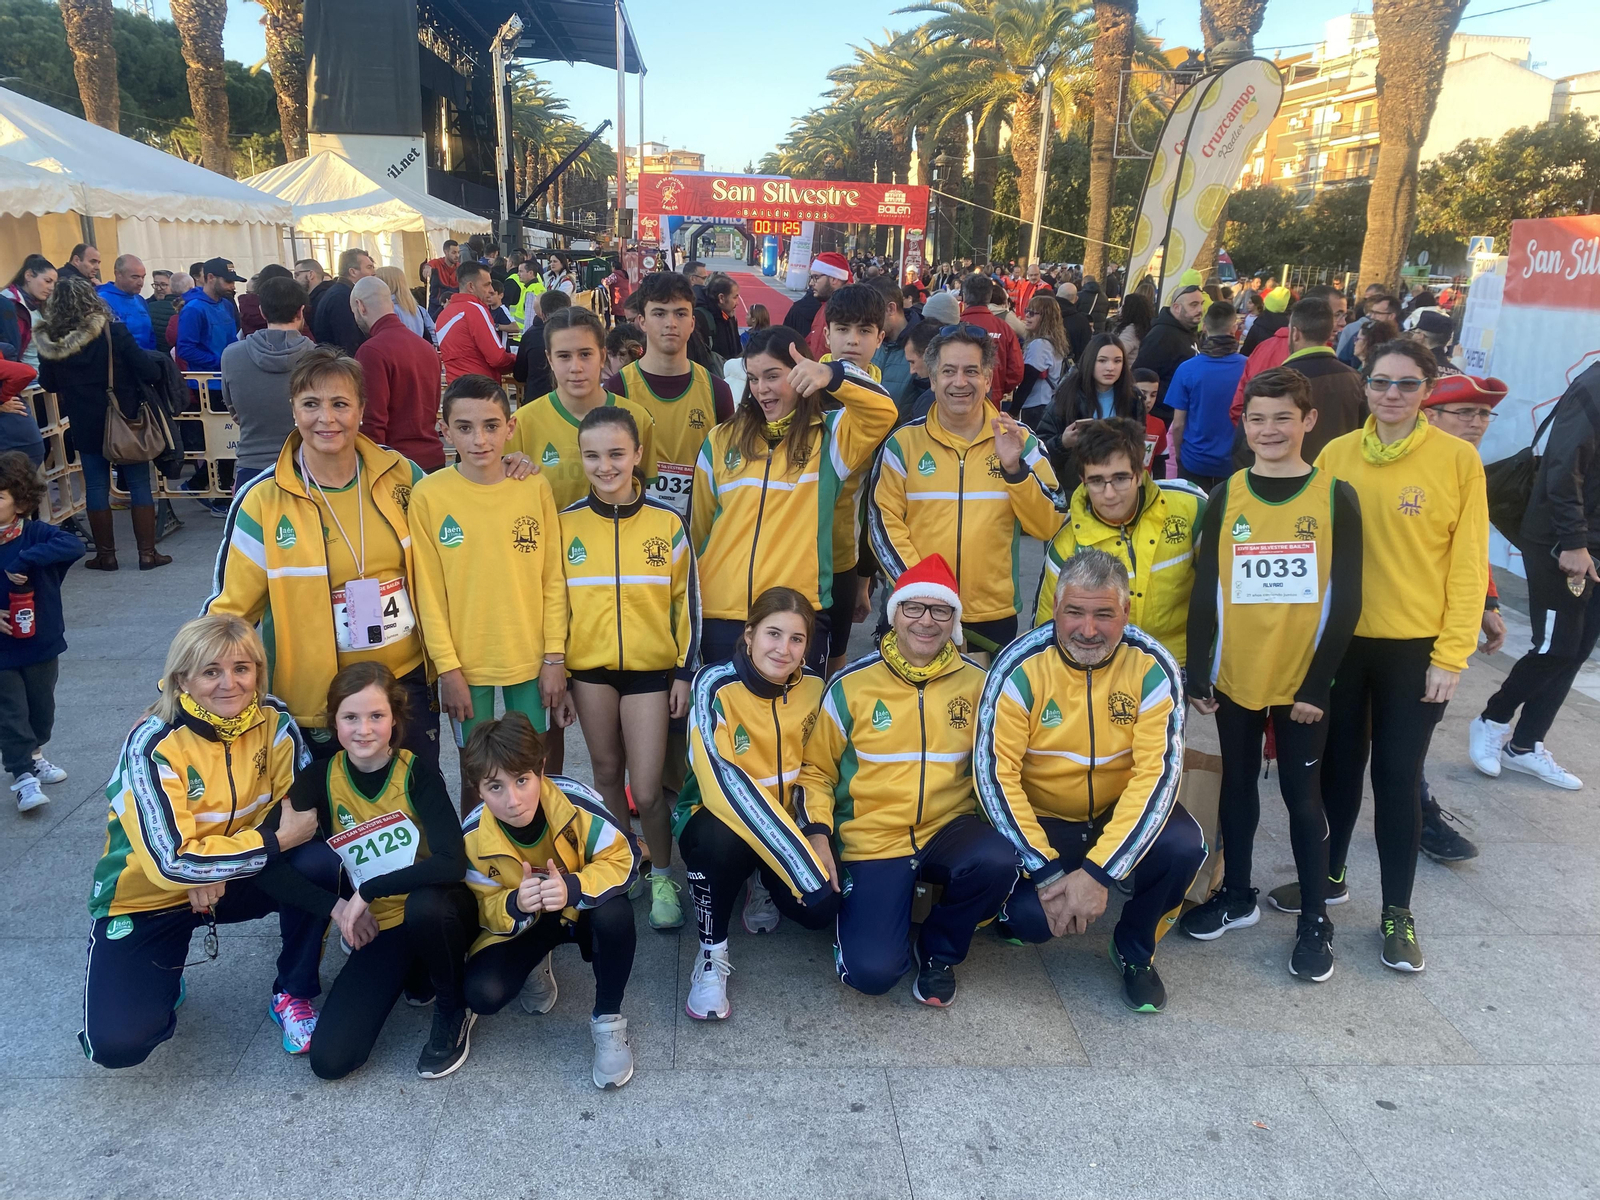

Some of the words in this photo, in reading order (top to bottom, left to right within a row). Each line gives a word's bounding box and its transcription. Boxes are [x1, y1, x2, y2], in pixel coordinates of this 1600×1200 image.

[1202, 84, 1256, 158] Cruzcampo
[1218, 124, 1245, 159] Radler
[387, 147, 420, 179] il.net
[712, 179, 756, 203] San
[762, 181, 860, 207] Silvestre
[743, 208, 790, 218] BAILÉN
[1523, 239, 1565, 279] San
[1566, 237, 1600, 280] Sil
[646, 475, 692, 495] 032
[276, 526, 295, 541] Jaén
[441, 526, 461, 540] Jaén
[568, 546, 585, 559] Jaén
[1241, 558, 1308, 579] 1033
[1041, 709, 1061, 721] Jaén
[347, 829, 359, 838] SAN
[358, 818, 382, 833] SILVESTRE
[348, 826, 412, 866] 2129
[687, 871, 706, 880] oma
[107, 920, 130, 934] Jaén
